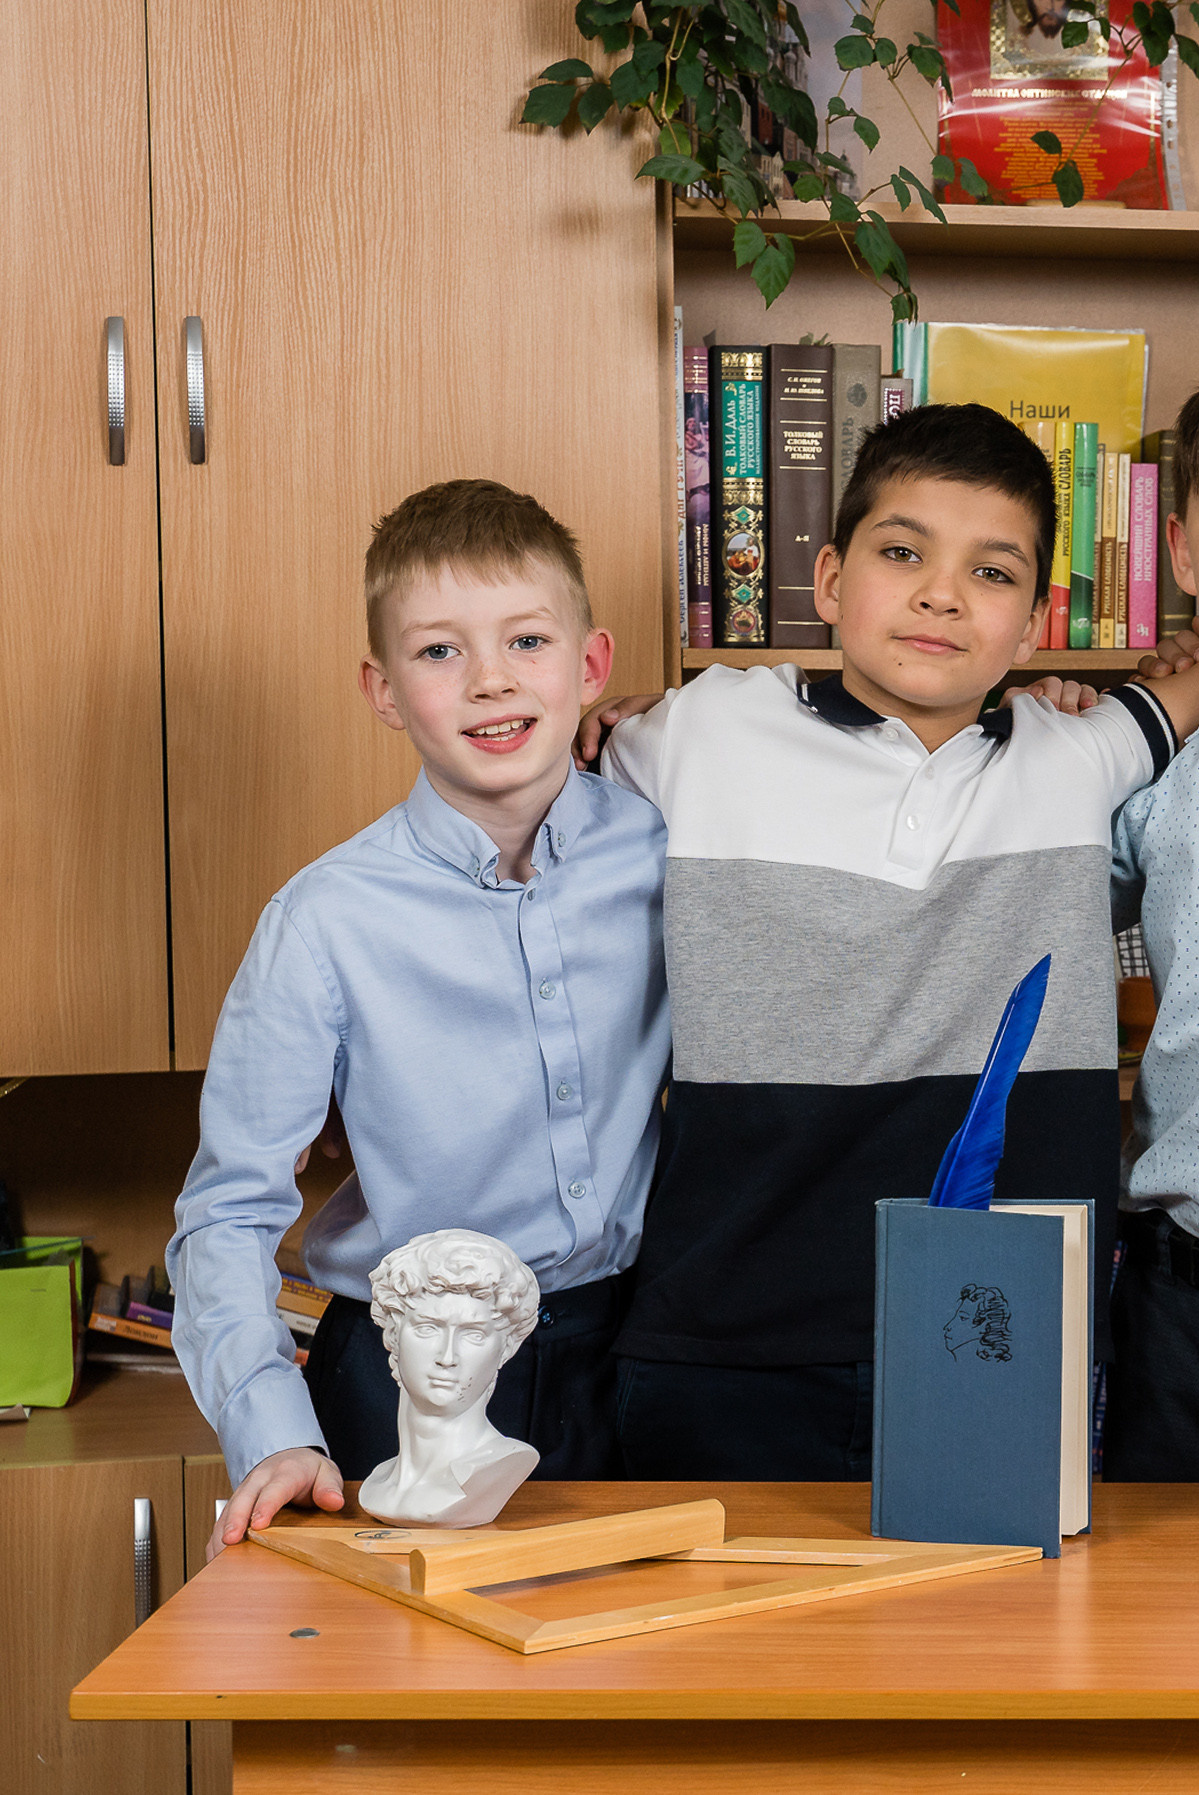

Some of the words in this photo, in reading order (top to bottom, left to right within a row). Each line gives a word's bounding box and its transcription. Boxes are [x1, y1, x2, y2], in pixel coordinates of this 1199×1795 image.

[738, 383, 747, 423] СЛОВАРЬ
[1009, 400, 1070, 419] Наши
[738, 426, 747, 475] ТОЛКОВЫЙ
[747, 422, 755, 468] РУССКОГО
[782, 430, 824, 439] ТОЛКОВЫЙ
[783, 445, 823, 453] РУССКОГО
[786, 438, 821, 446] СЛОВАРЬ
[1058, 447, 1072, 490] СЛОВАРЬ
[1063, 492, 1071, 517] ЯЗЫКА
[1134, 476, 1144, 522] СЛОВАРЬ
[1144, 477, 1154, 505] СЛОВ
[1062, 519, 1072, 557] РУССКОГО
[1133, 524, 1143, 581] НОВЕЙШИЙ
[1143, 508, 1153, 582] ИНОСТРАННЫХ
[1103, 541, 1114, 585] СЛОВЕСНОСТЬ
[1119, 543, 1128, 590] СЛОВЕСНОСТЬ
[1103, 586, 1112, 614] РУССКАЯ
[1118, 590, 1126, 622] РУССКАЯ
